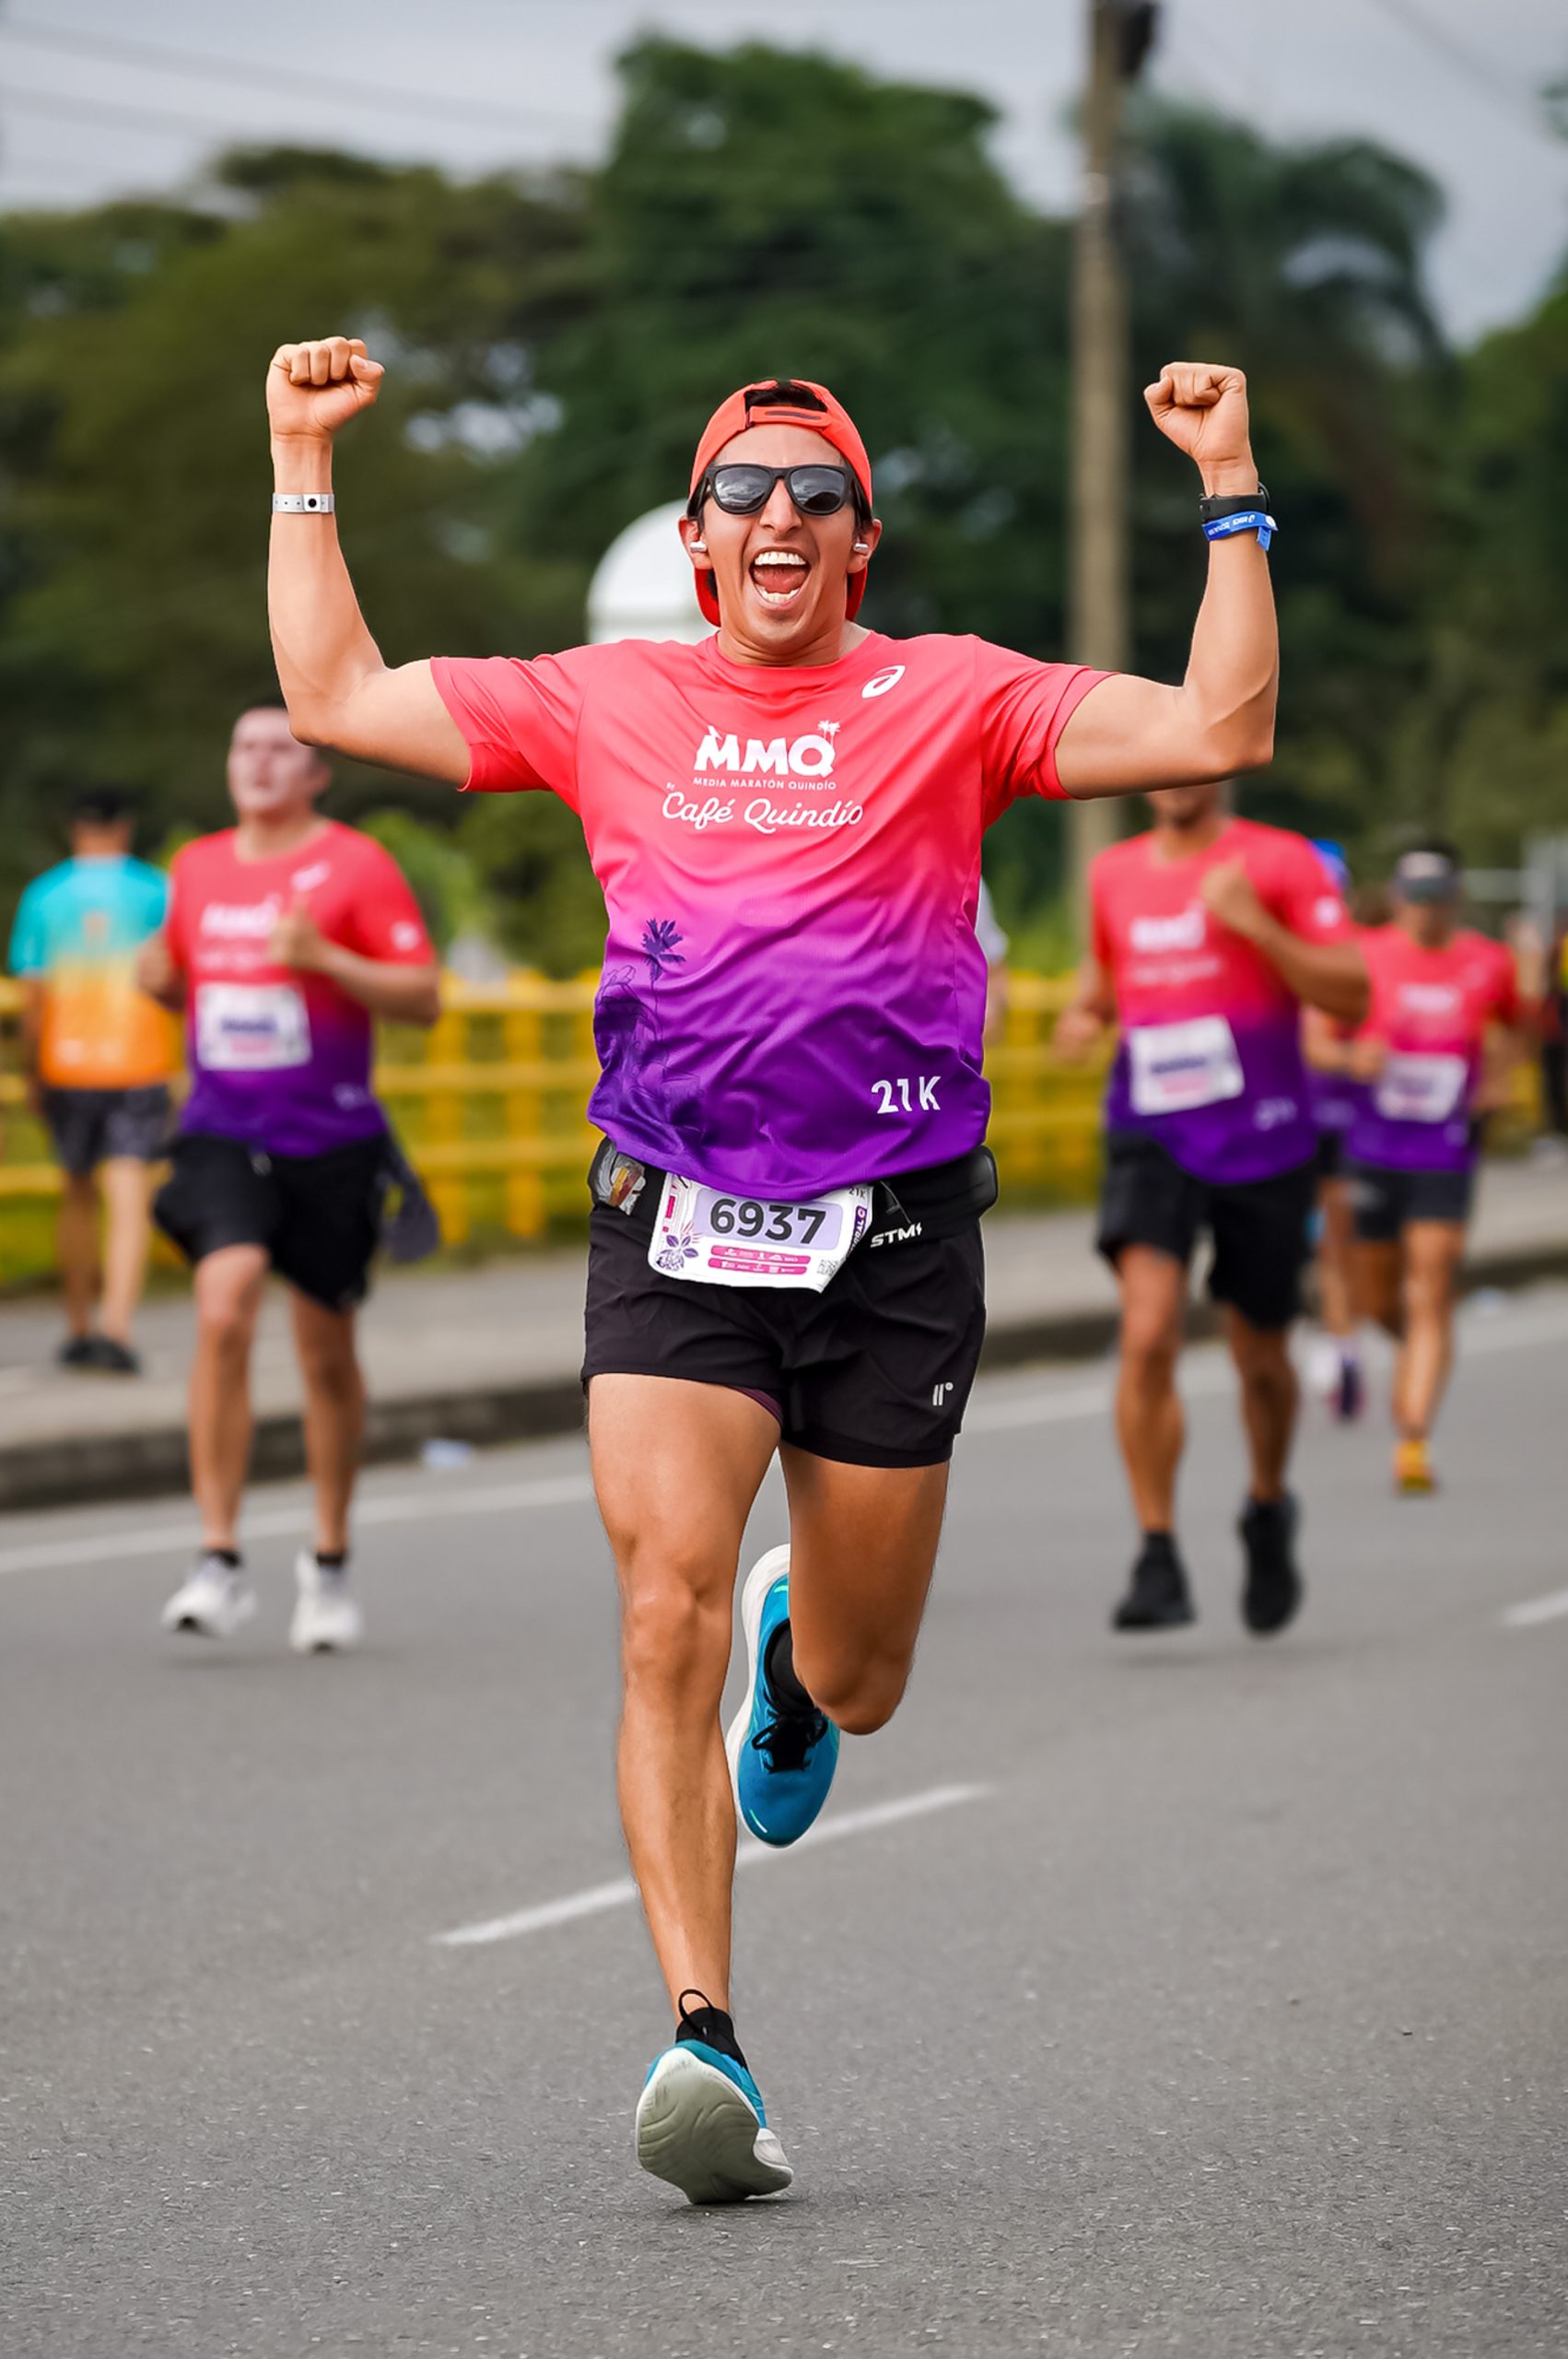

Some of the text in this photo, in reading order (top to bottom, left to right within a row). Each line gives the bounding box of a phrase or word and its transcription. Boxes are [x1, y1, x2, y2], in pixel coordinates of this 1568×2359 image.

[694, 725, 837, 778] MMQ
[693, 777, 837, 791] MEDIA MARATÓN QUINDÍO
[662, 792, 863, 834] Café Quindío
[871, 1075, 942, 1114] 21K
[710, 1199, 826, 1245] 6937
